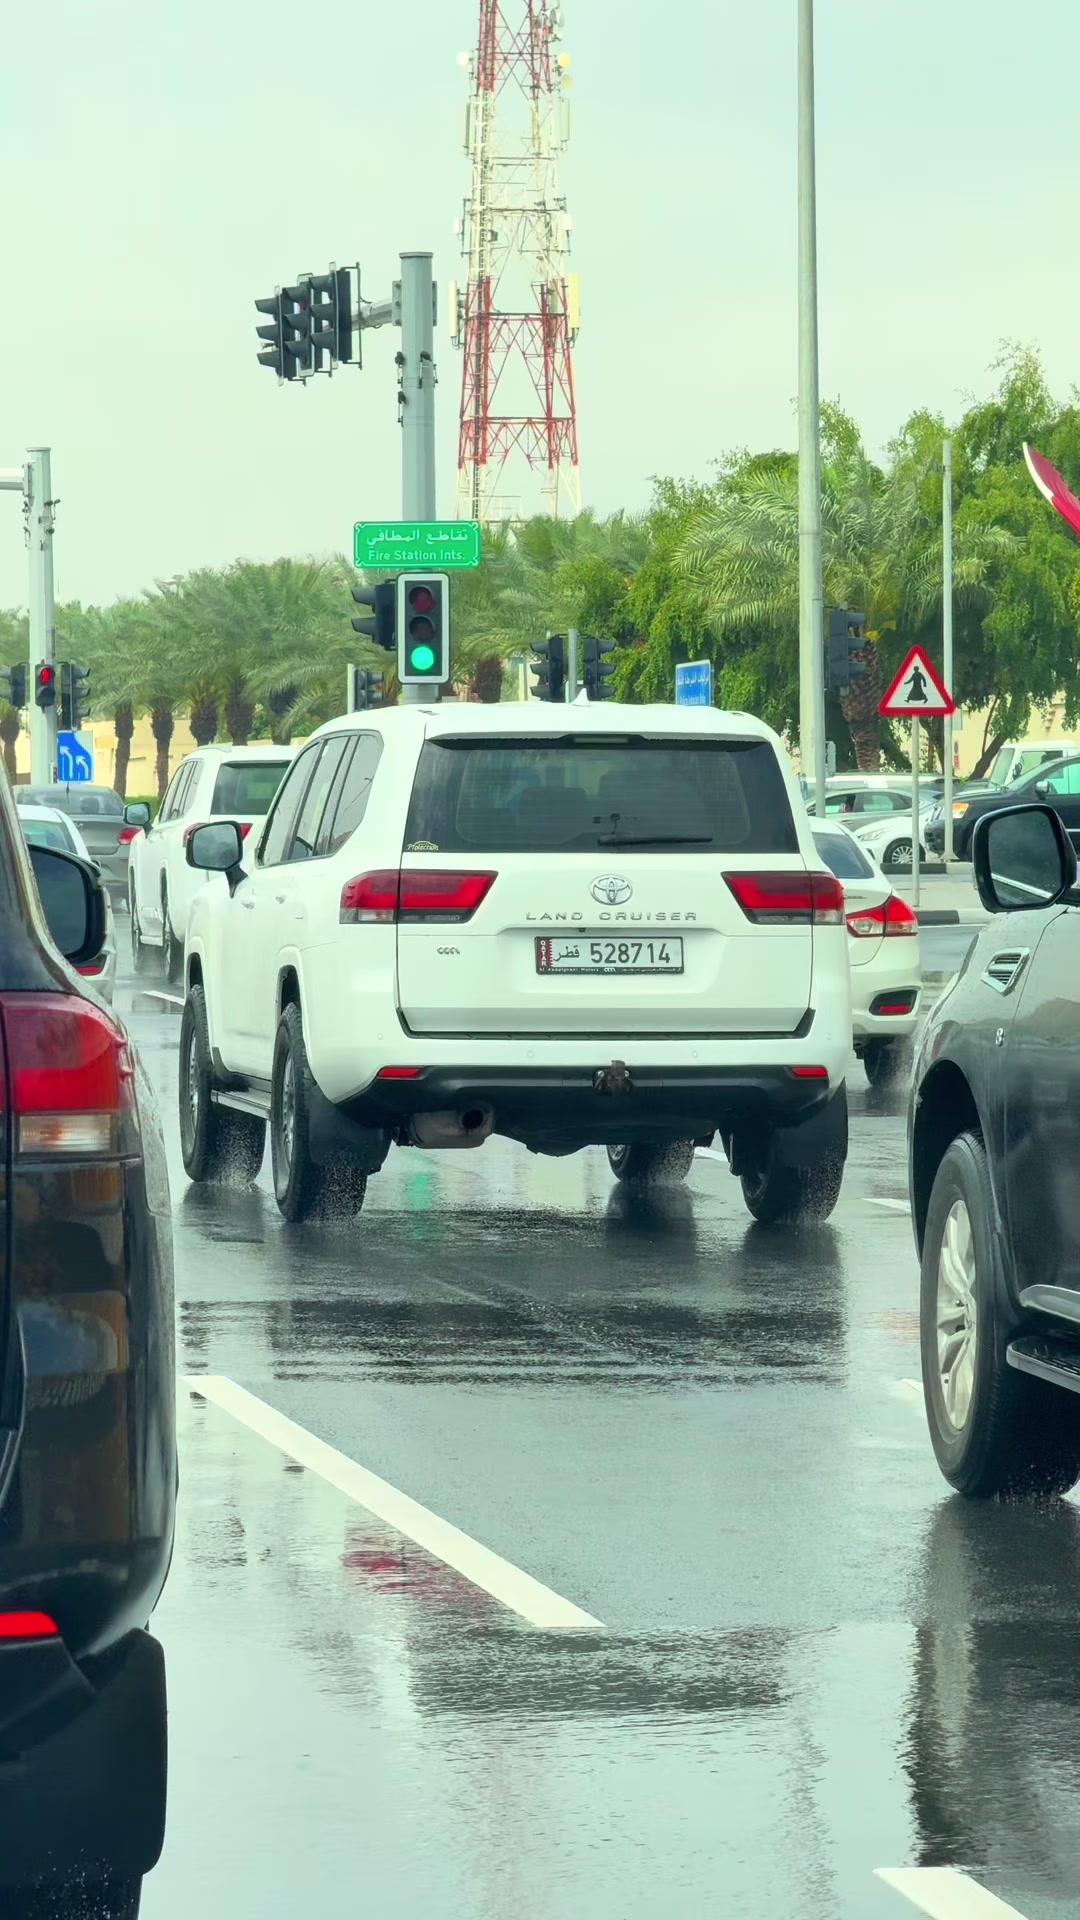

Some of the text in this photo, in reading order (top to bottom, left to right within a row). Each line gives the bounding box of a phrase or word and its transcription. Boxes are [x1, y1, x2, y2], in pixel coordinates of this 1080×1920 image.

[366, 529, 468, 549] تقاطع المطافي
[368, 549, 465, 560] Fire Station Ints.
[526, 912, 697, 920] LAND CRUISER
[553, 944, 580, 962] قطر
[590, 943, 671, 964] 528714
